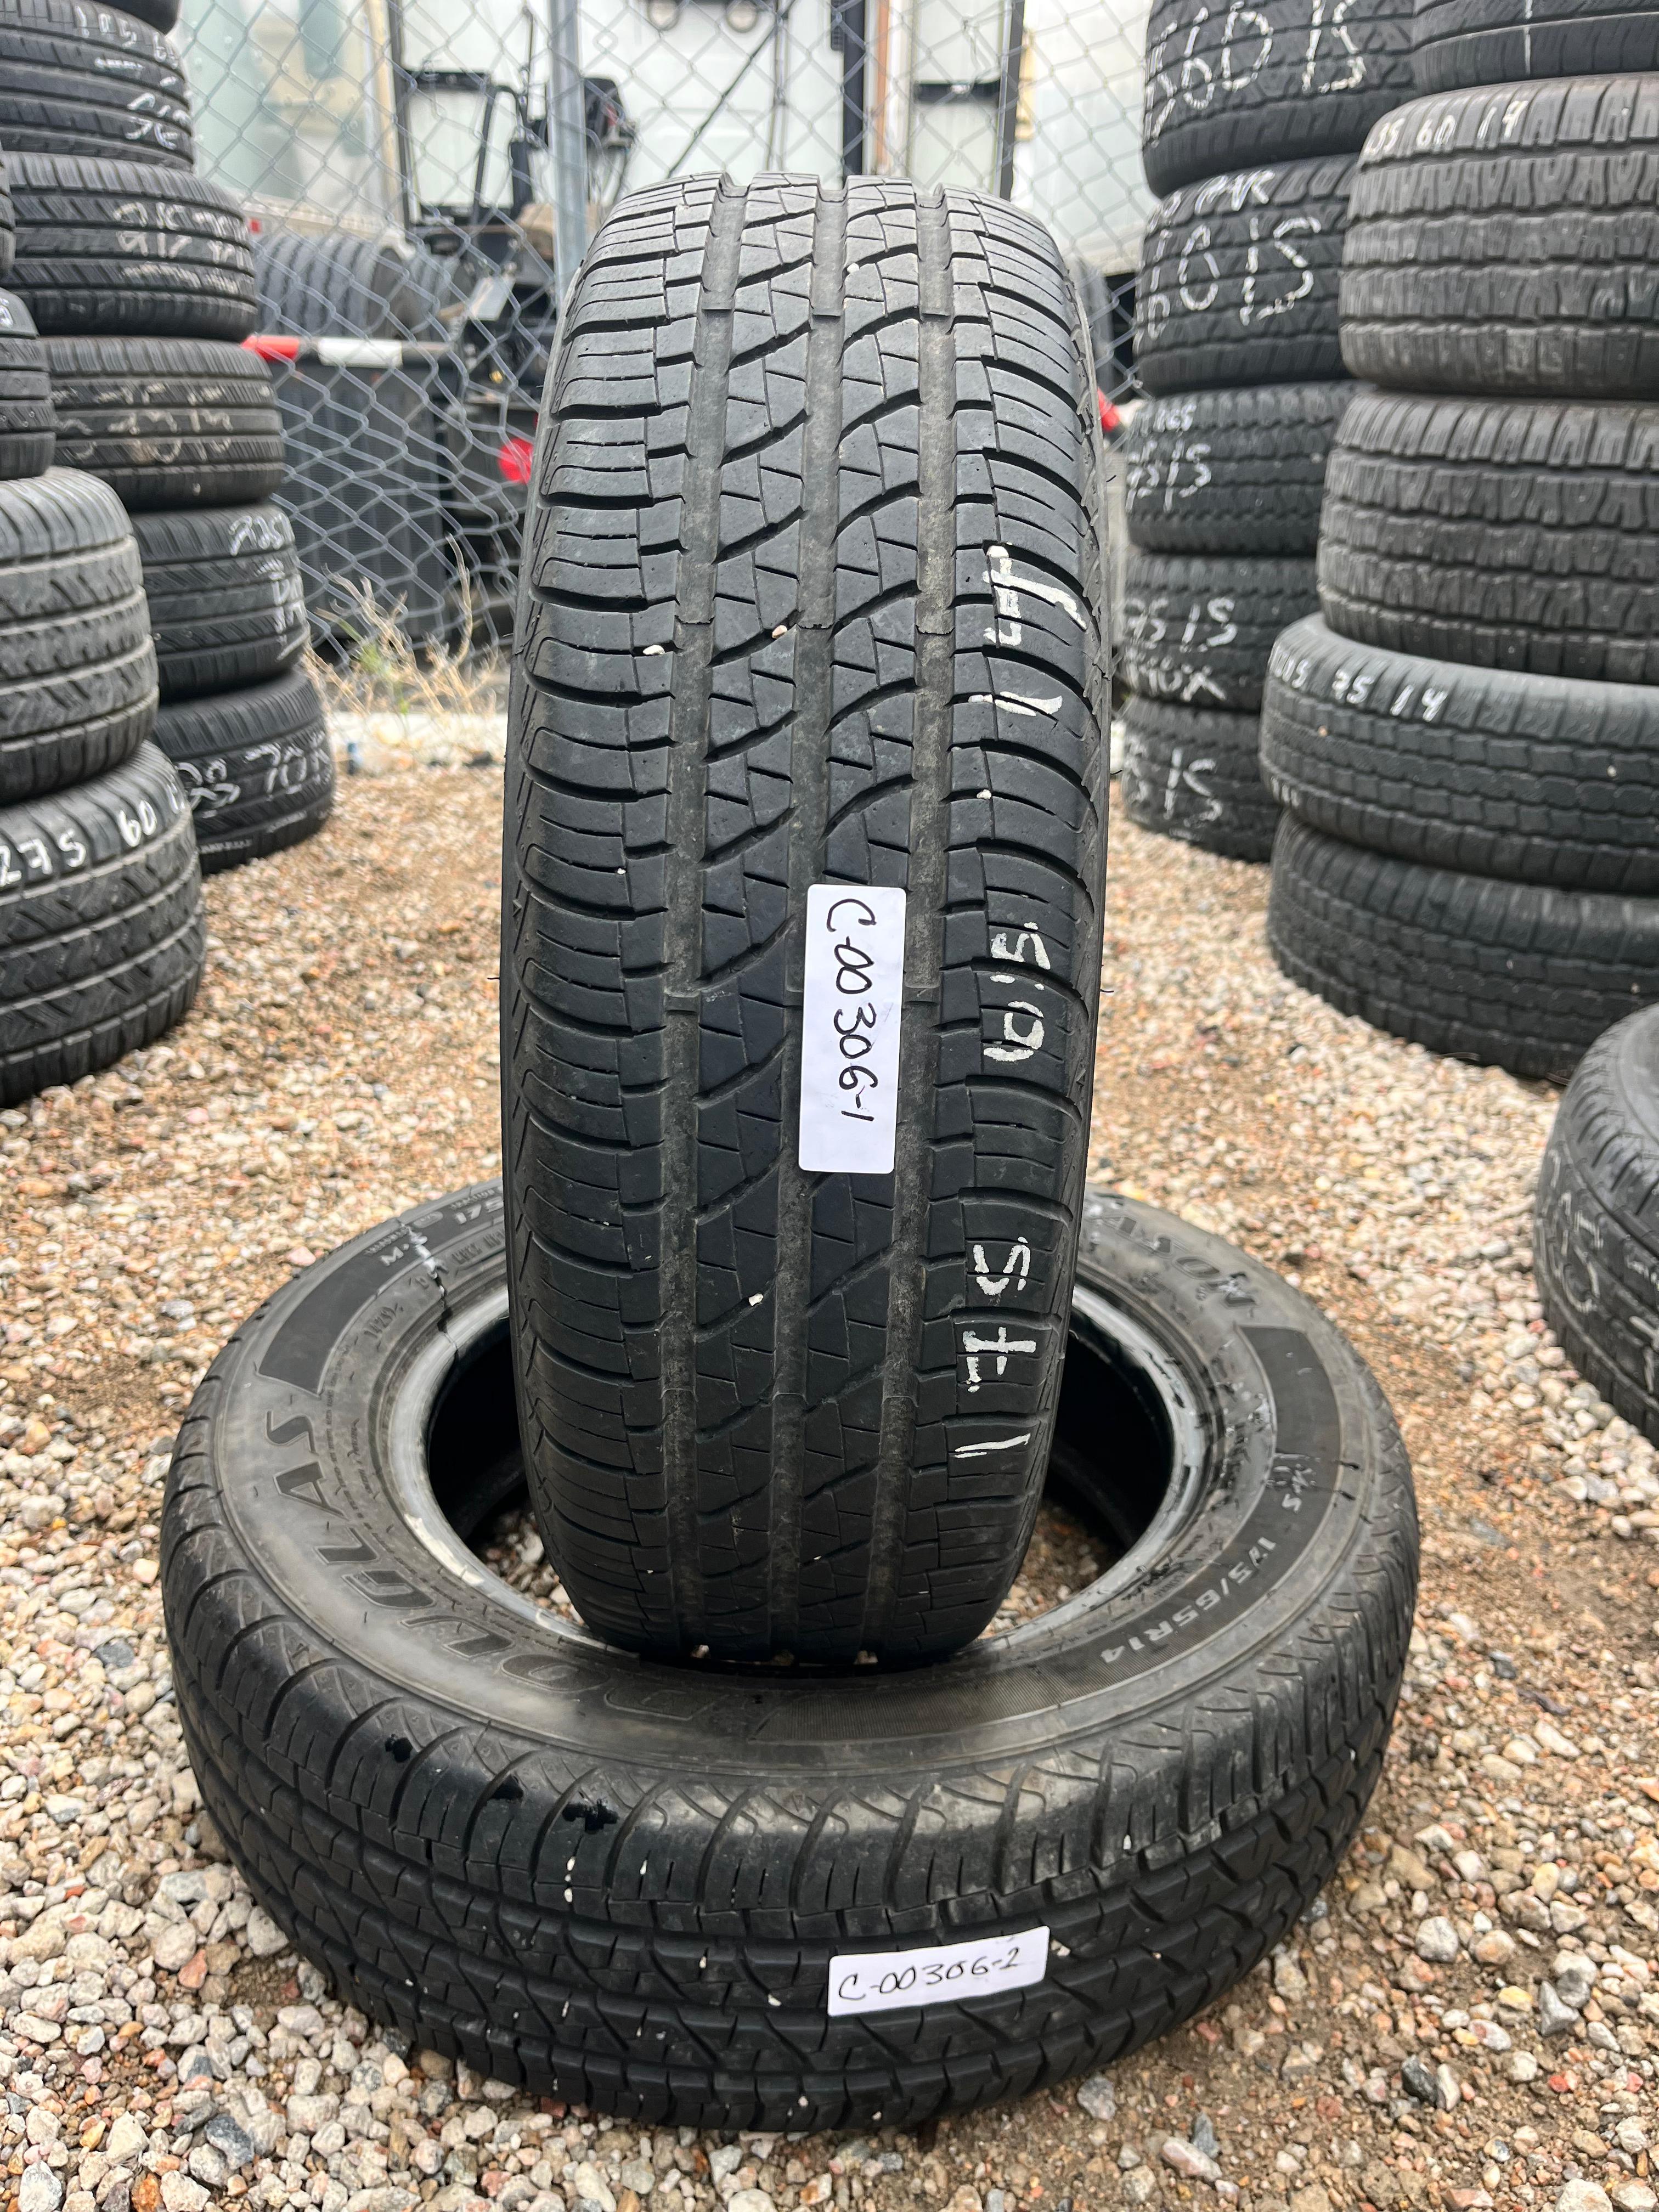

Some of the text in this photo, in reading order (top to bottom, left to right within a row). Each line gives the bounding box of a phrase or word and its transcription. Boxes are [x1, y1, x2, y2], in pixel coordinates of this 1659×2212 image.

[1180, 596, 1238, 653] 15
[117, 799, 158, 848] 60
[838, 1946, 1020, 2001] C-00306-2
